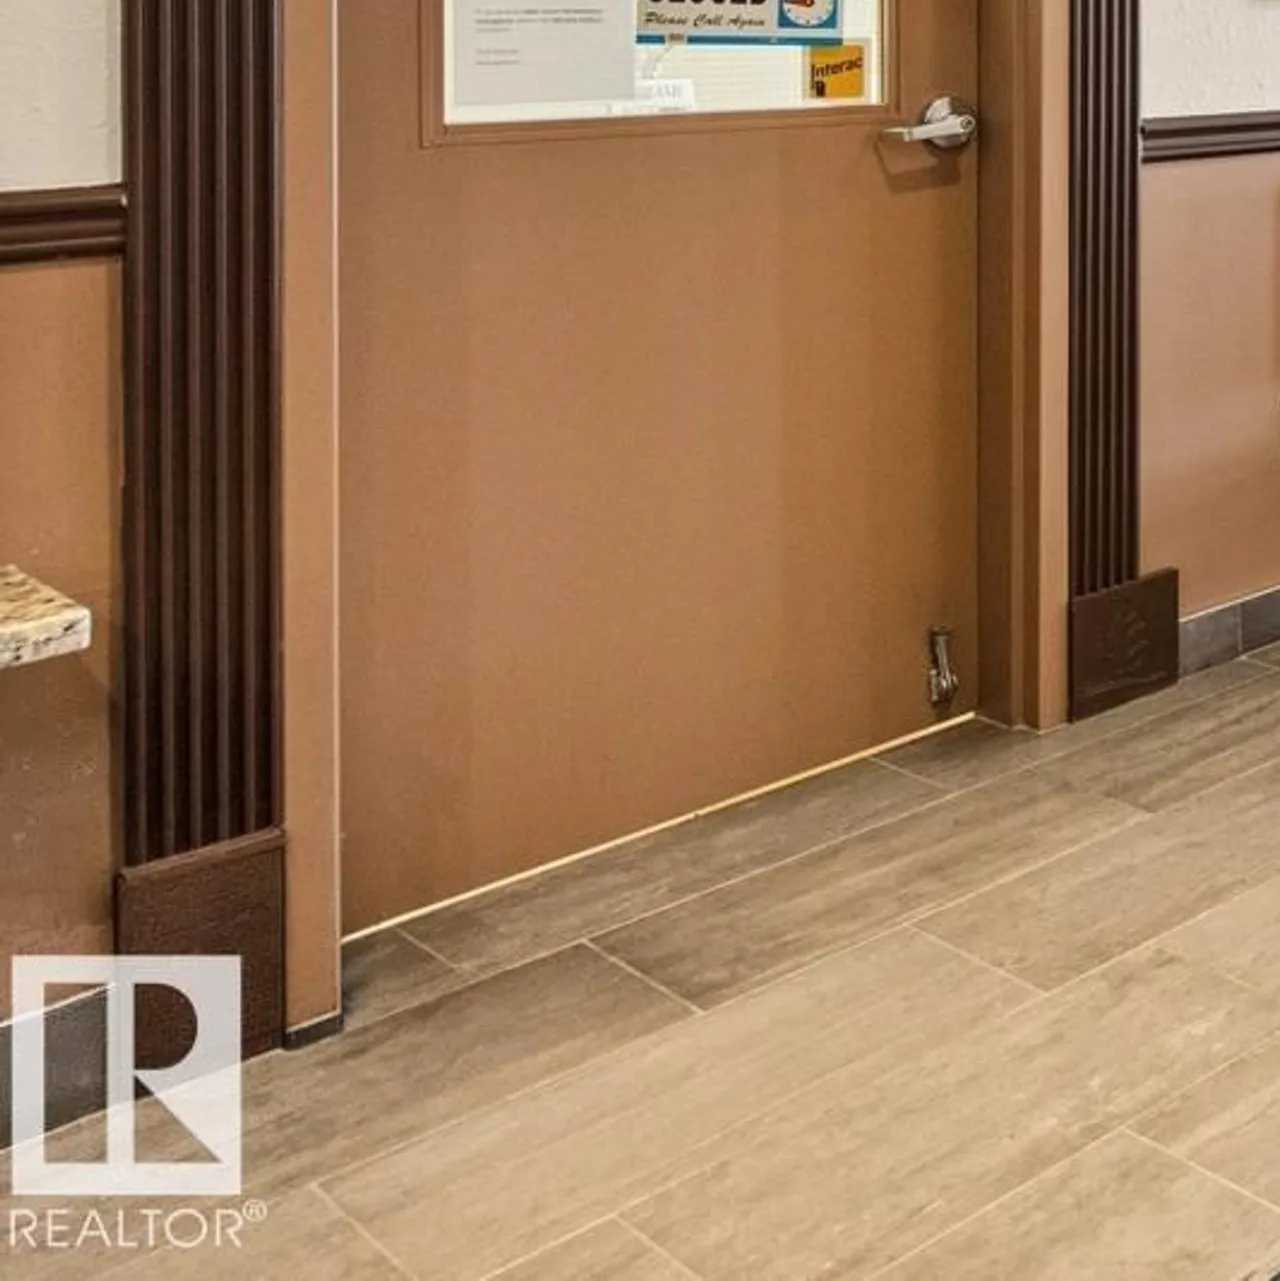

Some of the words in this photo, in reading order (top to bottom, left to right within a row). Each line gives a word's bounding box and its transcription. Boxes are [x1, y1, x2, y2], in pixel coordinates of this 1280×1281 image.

[644, 11, 688, 25] Please
[693, 13, 723, 28] Call
[727, 14, 765, 31] Again
[811, 56, 863, 87] Interac
